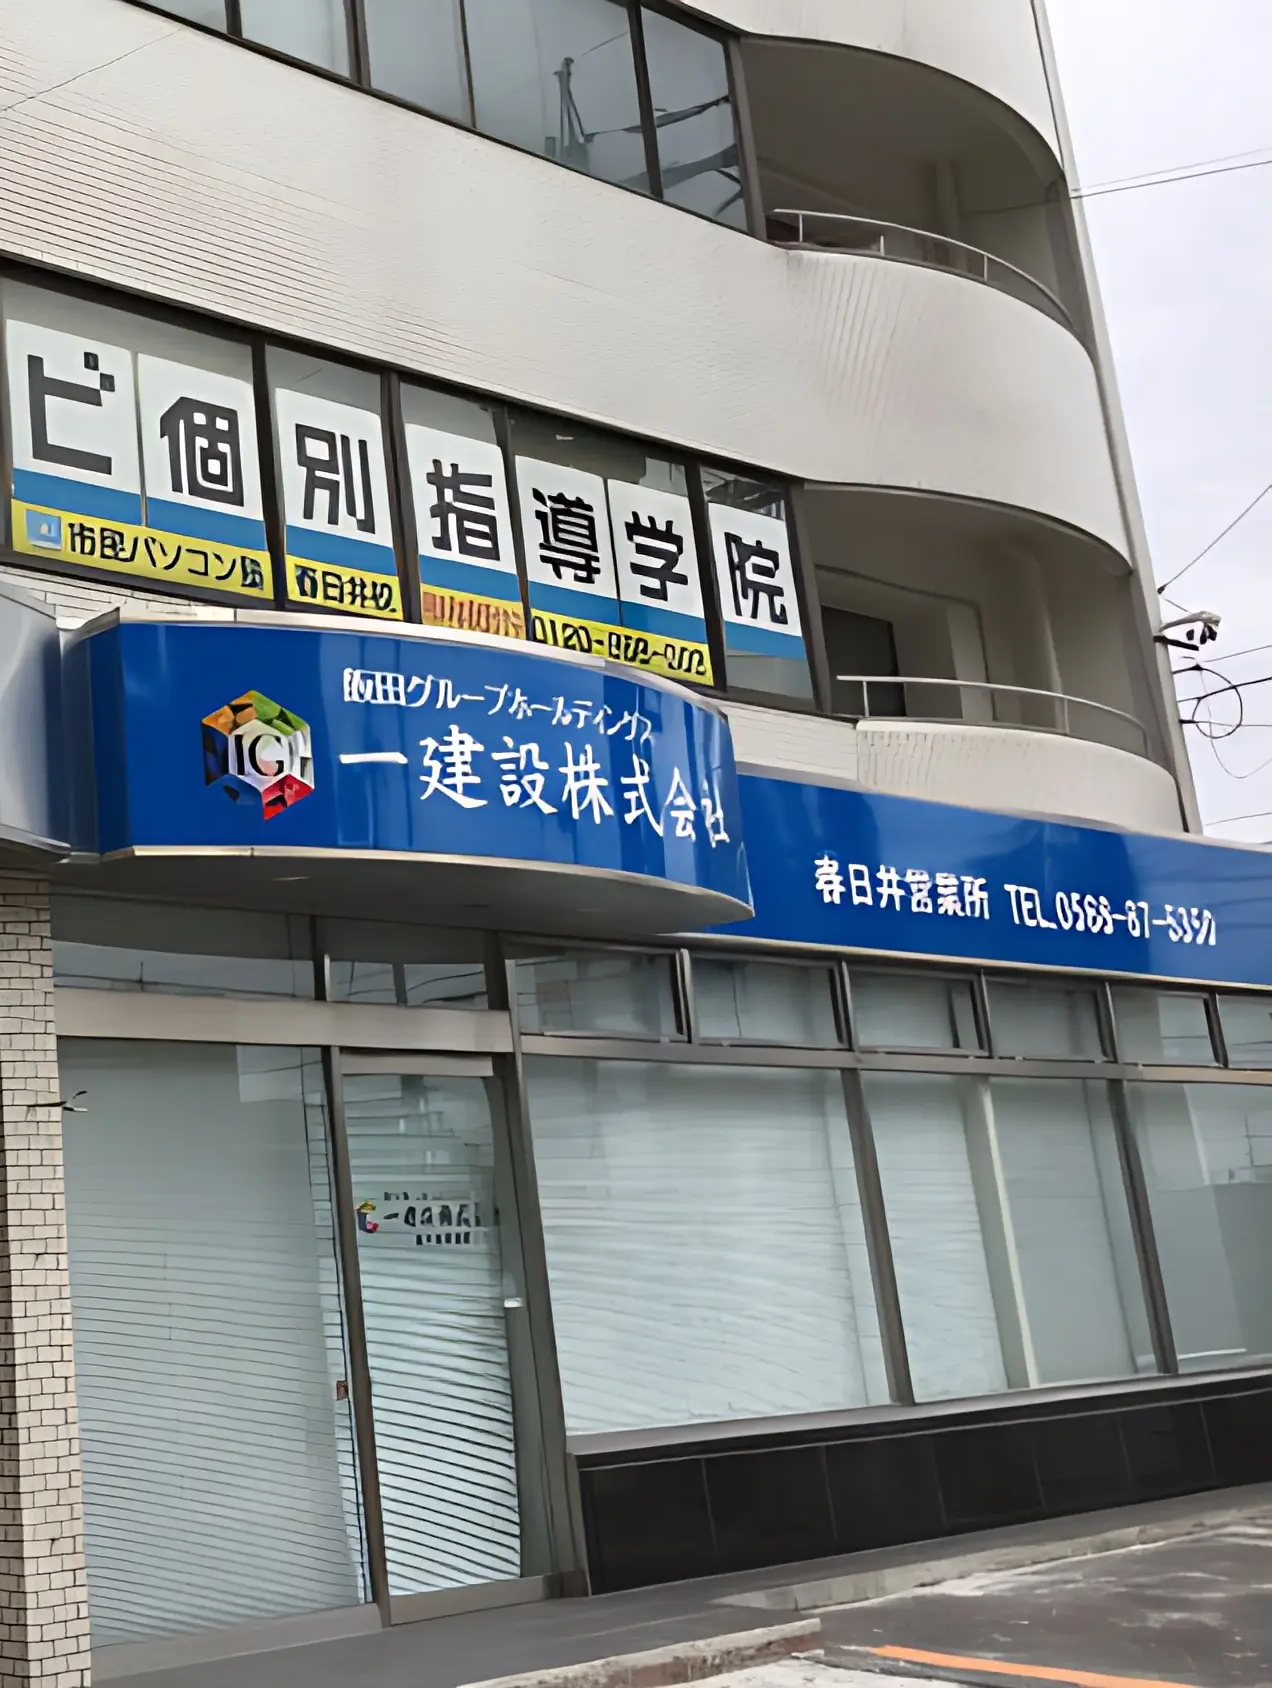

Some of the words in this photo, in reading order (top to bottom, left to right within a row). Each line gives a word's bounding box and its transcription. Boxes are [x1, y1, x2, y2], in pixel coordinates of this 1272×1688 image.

[339, 724, 731, 848] 一建設株式会社
[814, 853, 990, 920] 春日井営業所
